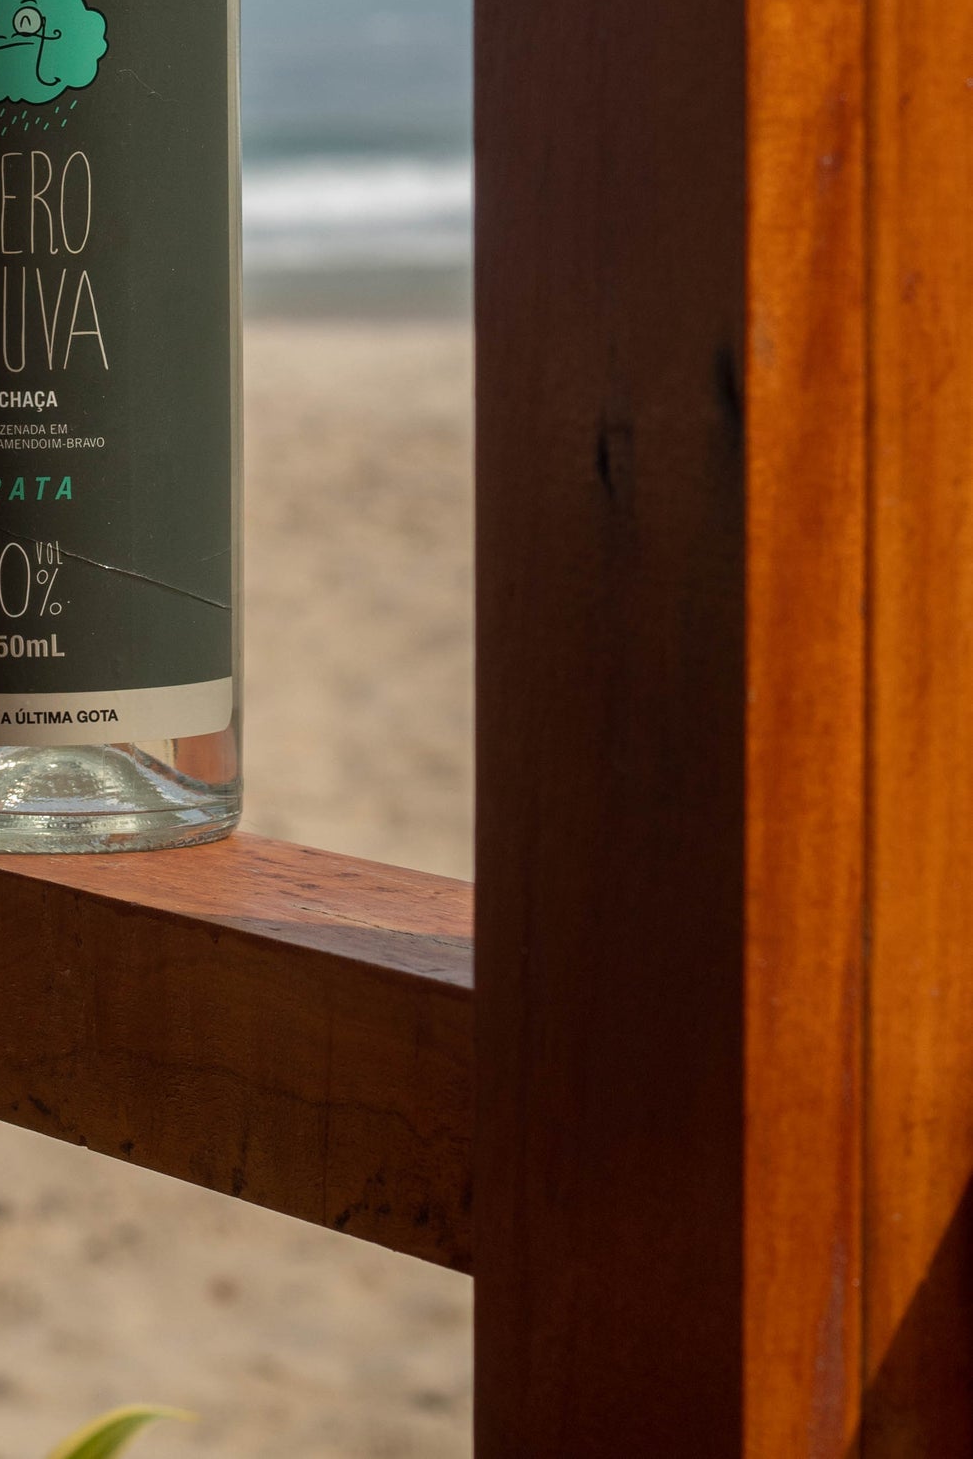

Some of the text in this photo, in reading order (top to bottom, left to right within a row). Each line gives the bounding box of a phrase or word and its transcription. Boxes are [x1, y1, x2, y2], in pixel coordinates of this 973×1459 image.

[50, 423, 68, 435] EM
[35, 540, 64, 565] VOL
[0, 711, 12, 725] A
[15, 708, 73, 725] ÚLTIMA
[77, 709, 119, 723] GOTA
